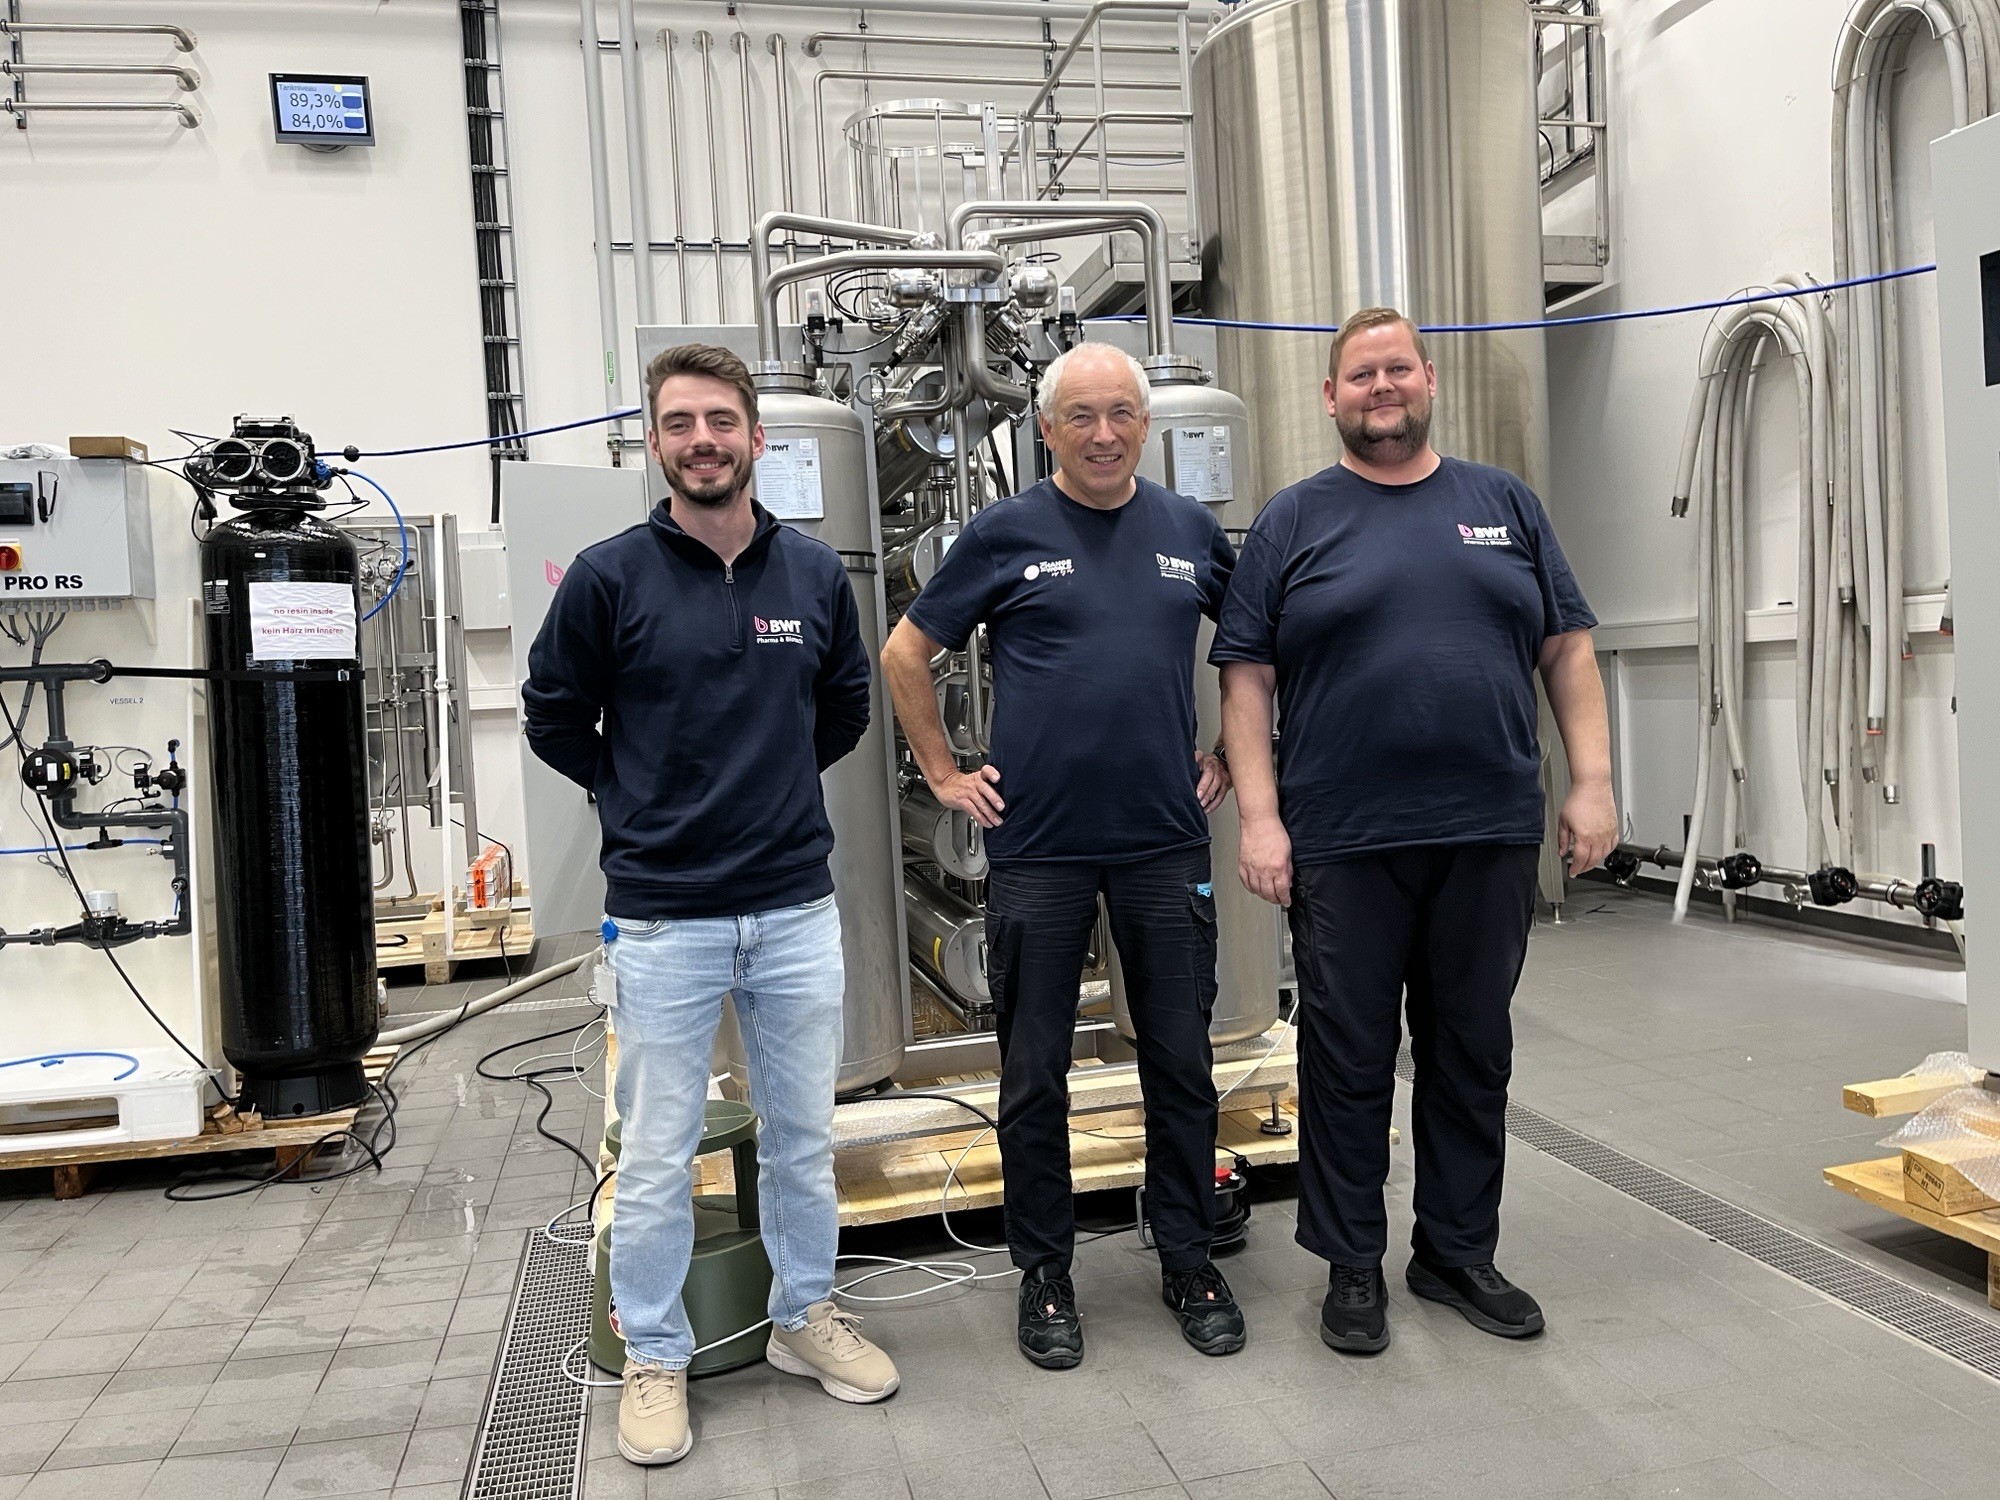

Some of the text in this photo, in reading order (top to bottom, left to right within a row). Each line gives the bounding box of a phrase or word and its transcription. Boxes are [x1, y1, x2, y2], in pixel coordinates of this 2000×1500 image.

[279, 83, 317, 92] Tankniveau
[289, 92, 341, 111] 89,3%
[292, 113, 343, 131] 84,0%
[771, 444, 789, 452] BWT
[1472, 525, 1508, 539] BWT
[1169, 556, 1195, 574] BWT
[5, 575, 83, 590] PRO RS
[287, 607, 309, 615] resin
[310, 607, 334, 615] inside
[261, 626, 281, 635] kein
[282, 626, 303, 634] Harz
[769, 619, 802, 634] BWT
[109, 697, 139, 705] VESSEL
